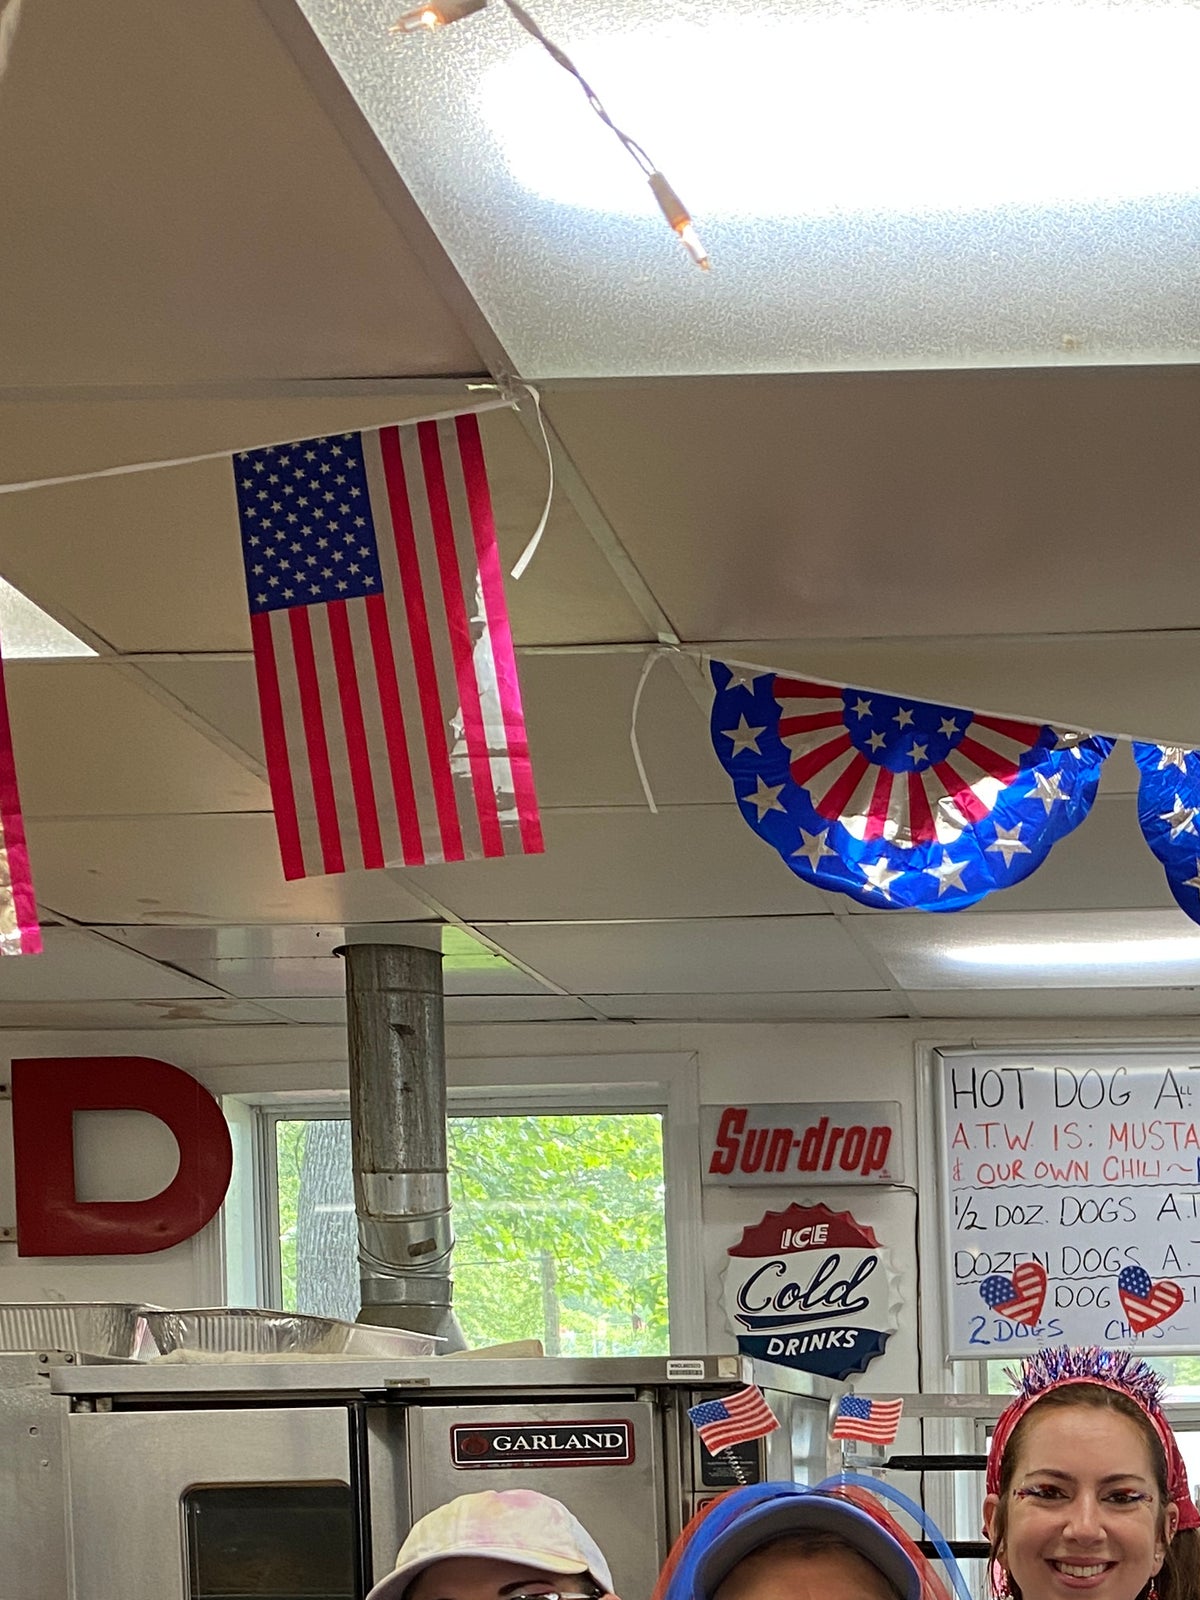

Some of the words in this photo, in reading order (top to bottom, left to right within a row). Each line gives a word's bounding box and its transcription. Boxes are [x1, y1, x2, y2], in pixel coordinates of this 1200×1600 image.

[952, 1066, 1034, 1109] HOT
[1054, 1066, 1131, 1109] DOG
[708, 1106, 892, 1176] Sun-drop
[1053, 1122, 1093, 1151] IS:
[12, 1056, 233, 1257] D
[977, 1158, 1026, 1185] OUR
[1034, 1160, 1089, 1182] OWN
[1060, 1196, 1136, 1226] DOGS
[781, 1223, 829, 1250] ICE
[955, 1250, 1049, 1279] DOZEN
[1062, 1245, 1140, 1276] DOGS
[737, 1254, 878, 1315] Cold
[1055, 1285, 1111, 1309] DOG
[766, 1329, 859, 1357] DRINKS
[968, 1315, 991, 1345] 2
[994, 1318, 1064, 1342] DOGS
[492, 1433, 624, 1451] GARLAND
